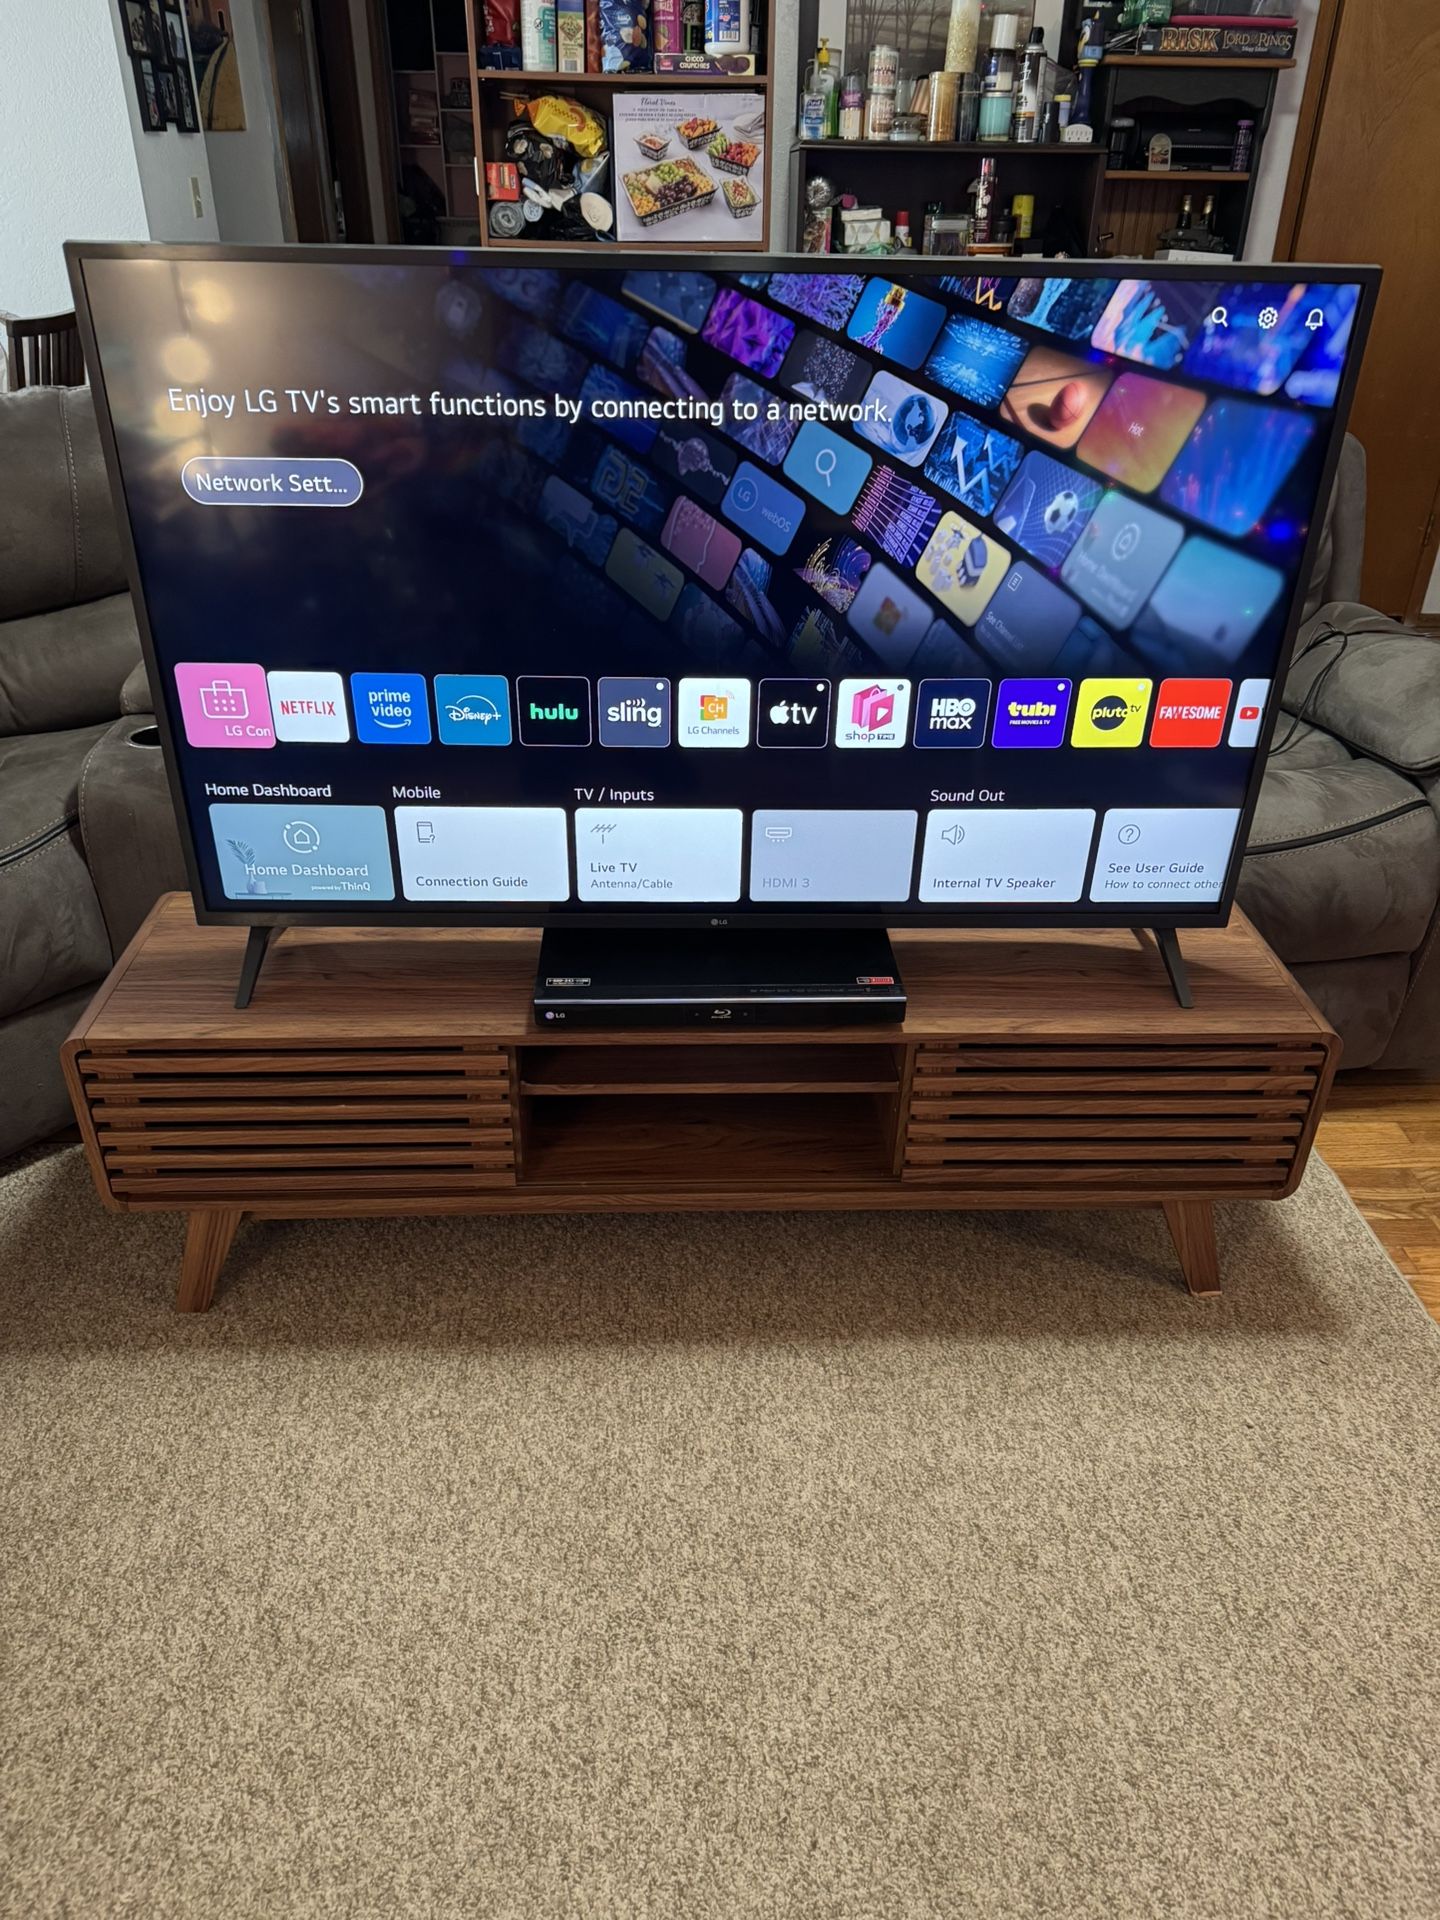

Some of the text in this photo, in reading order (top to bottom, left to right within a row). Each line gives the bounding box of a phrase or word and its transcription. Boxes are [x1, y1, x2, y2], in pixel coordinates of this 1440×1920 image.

[1160, 27, 1220, 52] RISK
[1223, 30, 1250, 49] LORD
[1258, 33, 1293, 50] RINGS
[169, 388, 892, 426] Enjoy LG TV's smart functions by connecting to a network.
[196, 473, 347, 493] Network Sett...
[737, 487, 752, 503] LG
[761, 507, 792, 533] webOS
[368, 688, 411, 704] prime
[280, 700, 336, 716] NETFLIX
[371, 703, 412, 717] video
[529, 702, 579, 720] hulu
[607, 698, 662, 727] sling
[708, 703, 725, 715] CH
[930, 697, 976, 717] HBO
[1008, 701, 1057, 717] tubi
[1092, 704, 1142, 720] pluto tv
[929, 716, 973, 730] max
[225, 725, 272, 738] LG Con
[687, 726, 740, 735] LG Channels
[845, 730, 875, 743] shop
[205, 783, 332, 798] Home Dashboard
[392, 786, 441, 799] Mobile
[574, 786, 654, 803] TV / Inputs
[930, 789, 1005, 802] Sound Out
[244, 863, 369, 877] Home Dashboard
[590, 862, 638, 873] Live TV
[1107, 862, 1205, 873] See User Guide
[340, 881, 371, 892] ThinQ
[416, 876, 528, 887] Connection Guide
[591, 879, 673, 889] Antenna/Cable
[762, 878, 811, 889] HDMI 3
[933, 878, 1057, 890] Internal TV Speaker
[1104, 880, 1129, 889] How
[1132, 881, 1144, 889] to
[1147, 880, 1191, 889] connect
